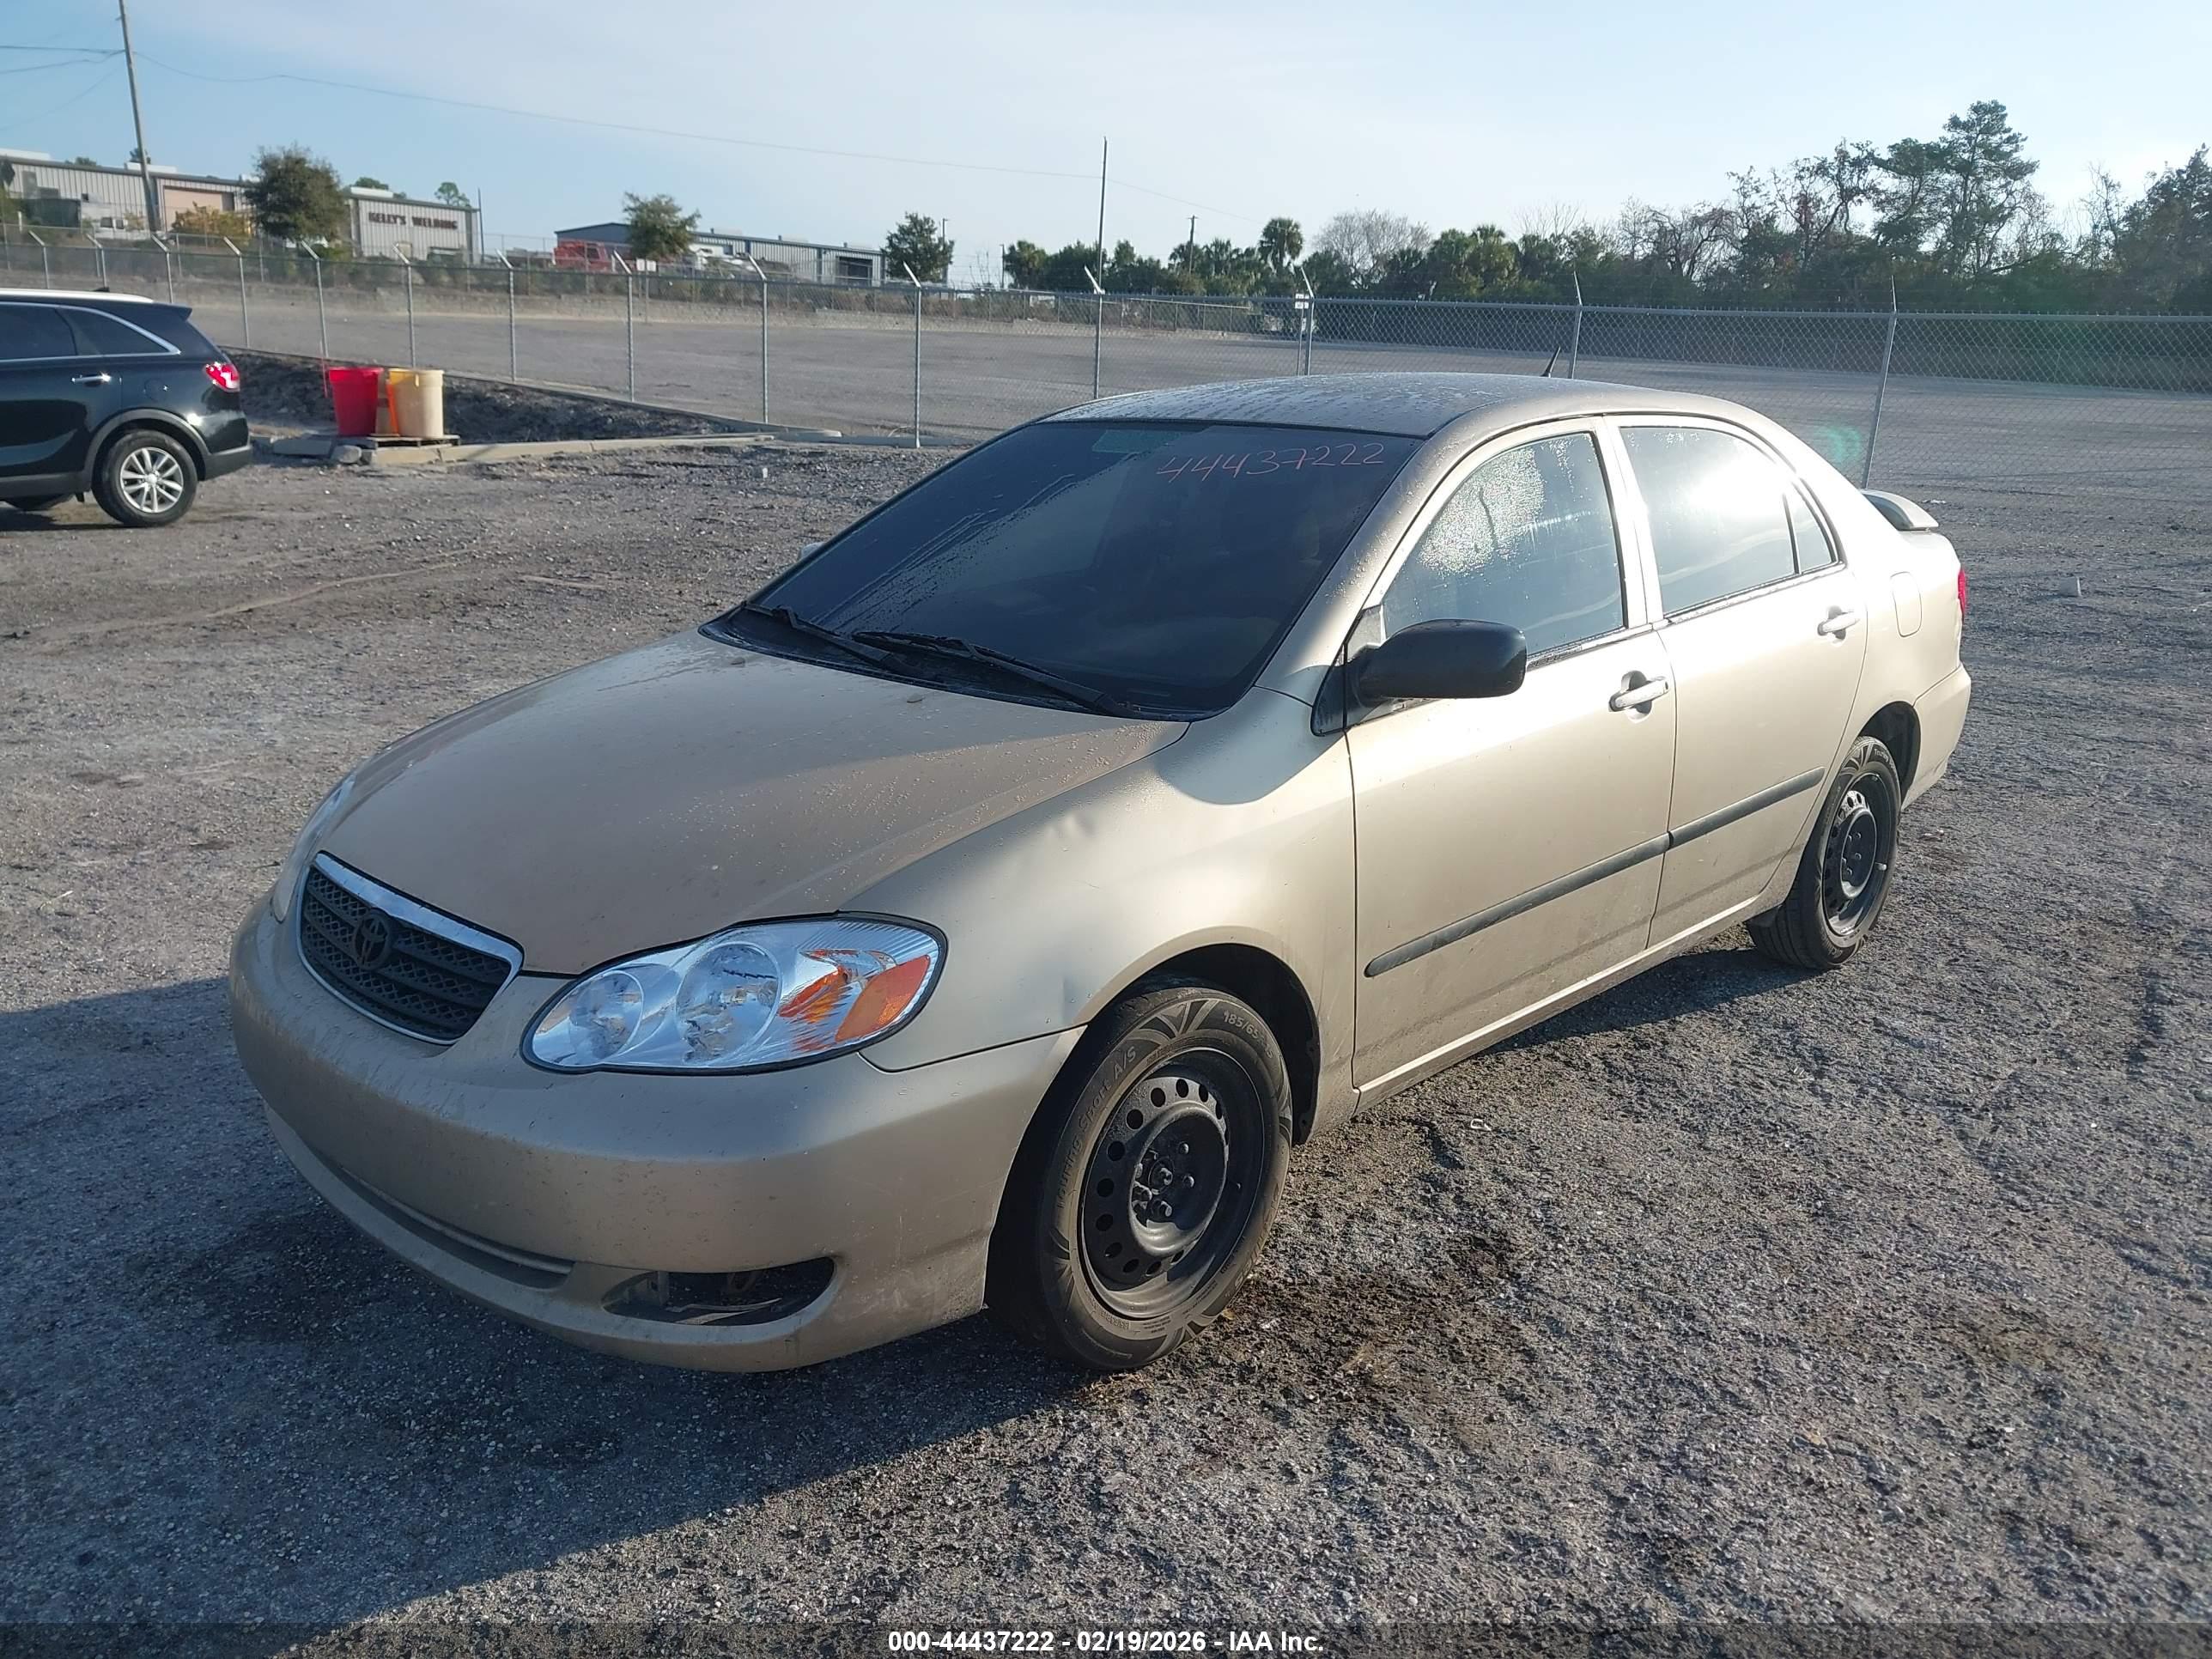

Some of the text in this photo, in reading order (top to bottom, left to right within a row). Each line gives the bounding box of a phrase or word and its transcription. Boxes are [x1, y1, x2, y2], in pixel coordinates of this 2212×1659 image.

[368, 210, 458, 230] KELLY'S WELDING
[1156, 442, 1385, 483] 44437222
[1112, 1045, 1137, 1080] A/S
